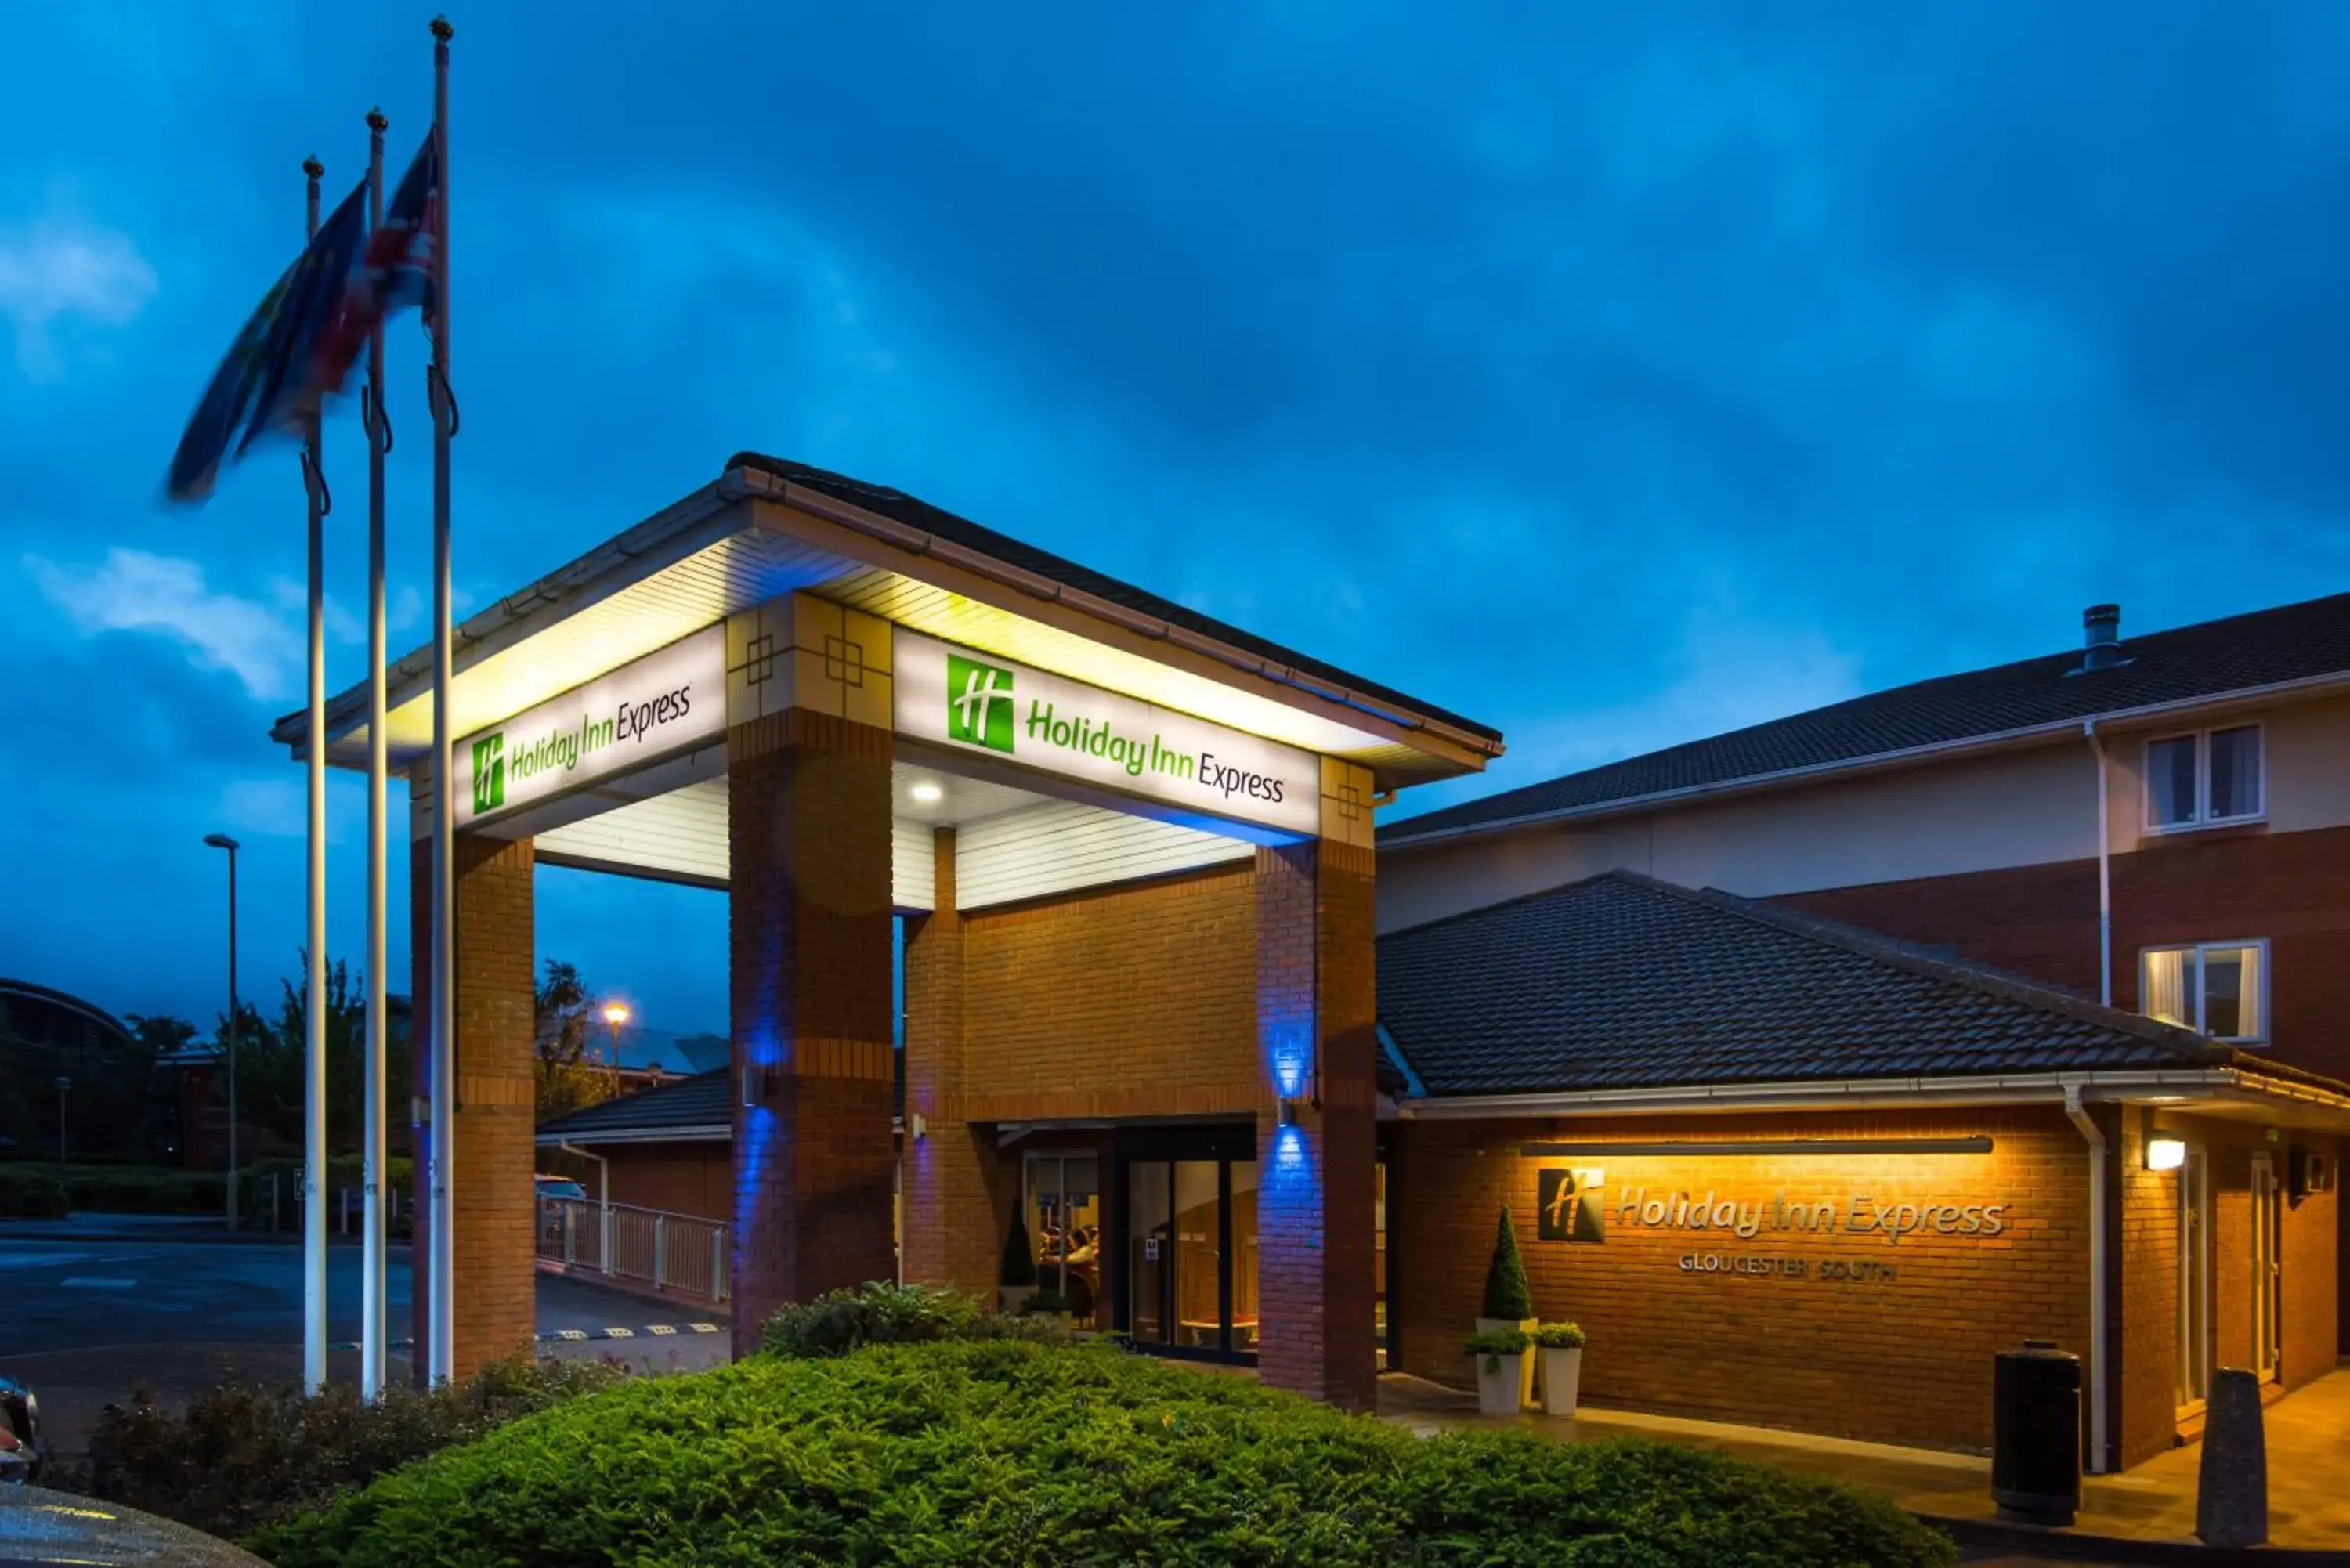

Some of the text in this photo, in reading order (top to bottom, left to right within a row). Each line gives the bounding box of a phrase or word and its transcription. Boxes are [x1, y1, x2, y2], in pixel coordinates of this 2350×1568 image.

[511, 730, 579, 782] Holiday
[582, 714, 613, 755] Inn
[616, 686, 691, 742] Express
[1026, 699, 1147, 777] Holiday
[1151, 734, 1194, 779] Inn
[1199, 753, 1285, 804] Express
[1615, 1186, 1762, 1239] Holiday
[1770, 1186, 1837, 1233] Inn
[1846, 1195, 2004, 1246] Express
[1679, 1252, 1810, 1278] GLOUCESTER
